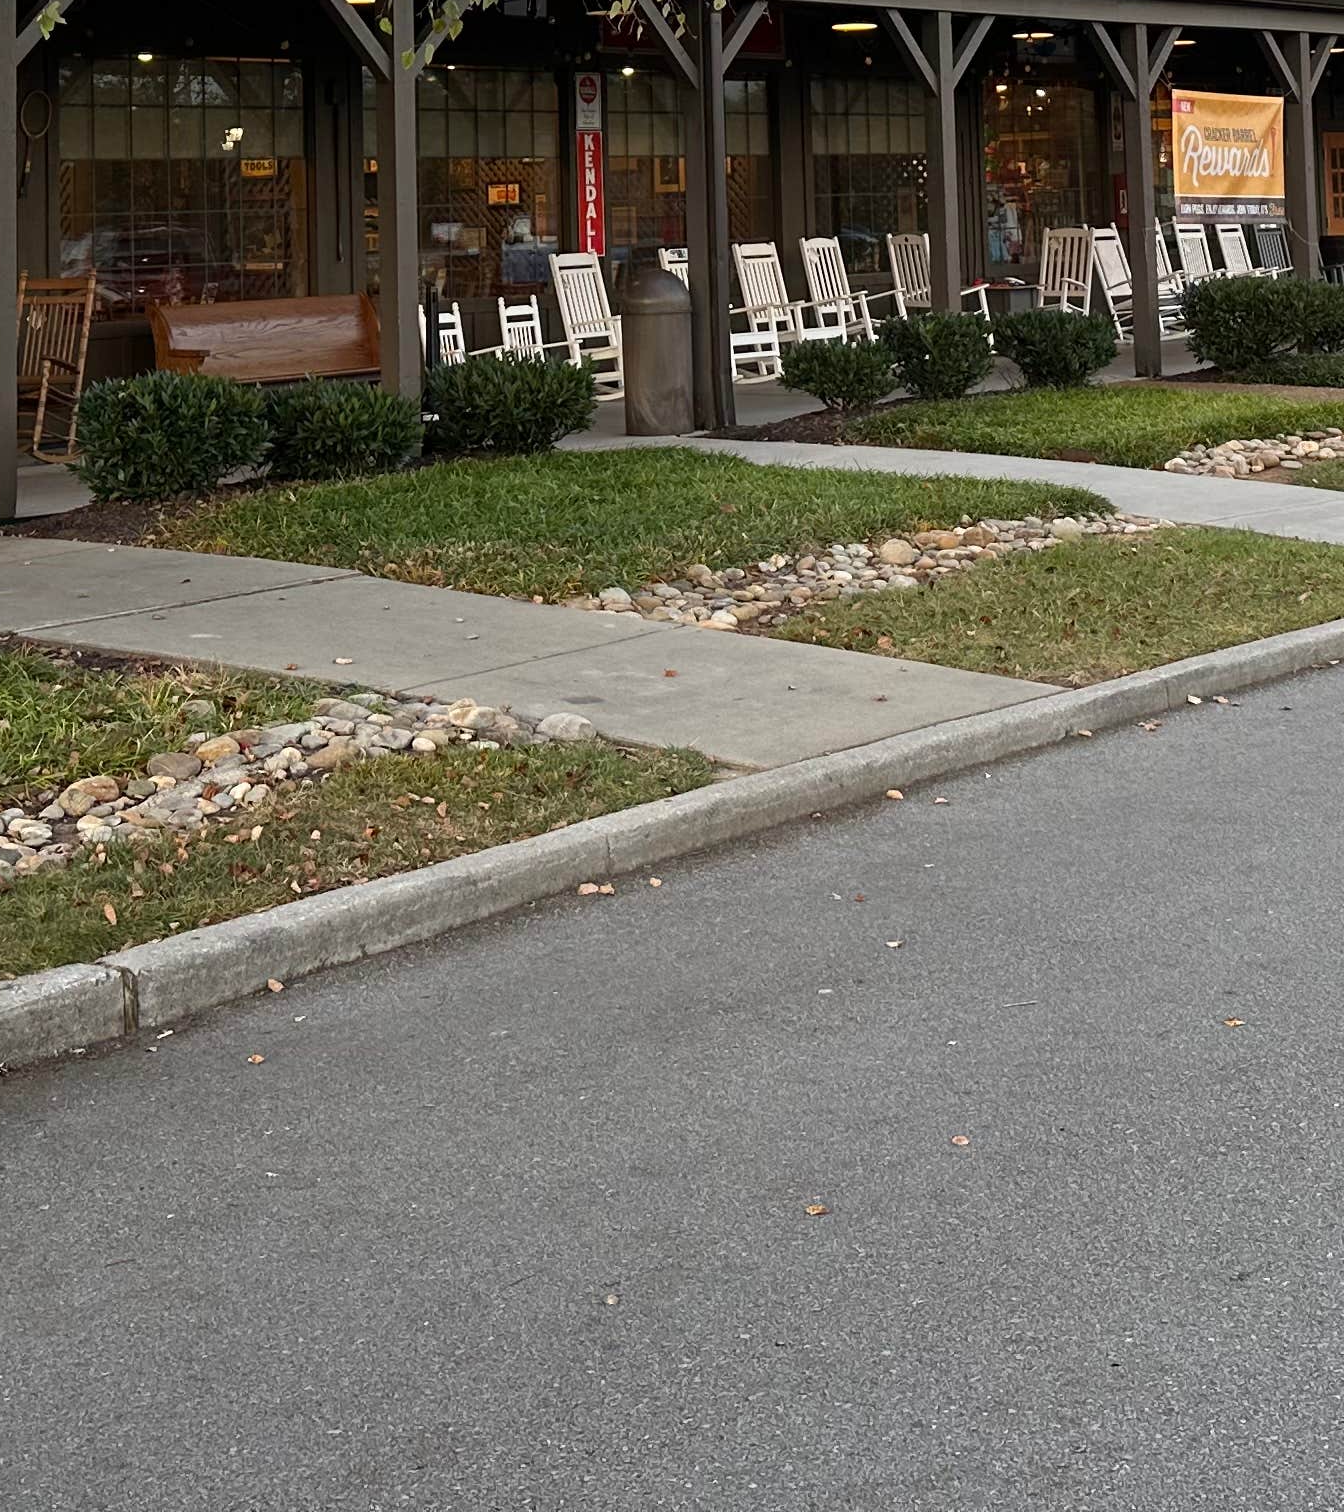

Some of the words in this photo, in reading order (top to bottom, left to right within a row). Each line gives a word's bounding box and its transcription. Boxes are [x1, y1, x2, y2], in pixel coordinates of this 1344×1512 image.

[244, 161, 273, 170] TOOLS
[1180, 124, 1270, 188] Rewards
[584, 134, 598, 253] KENDALL
